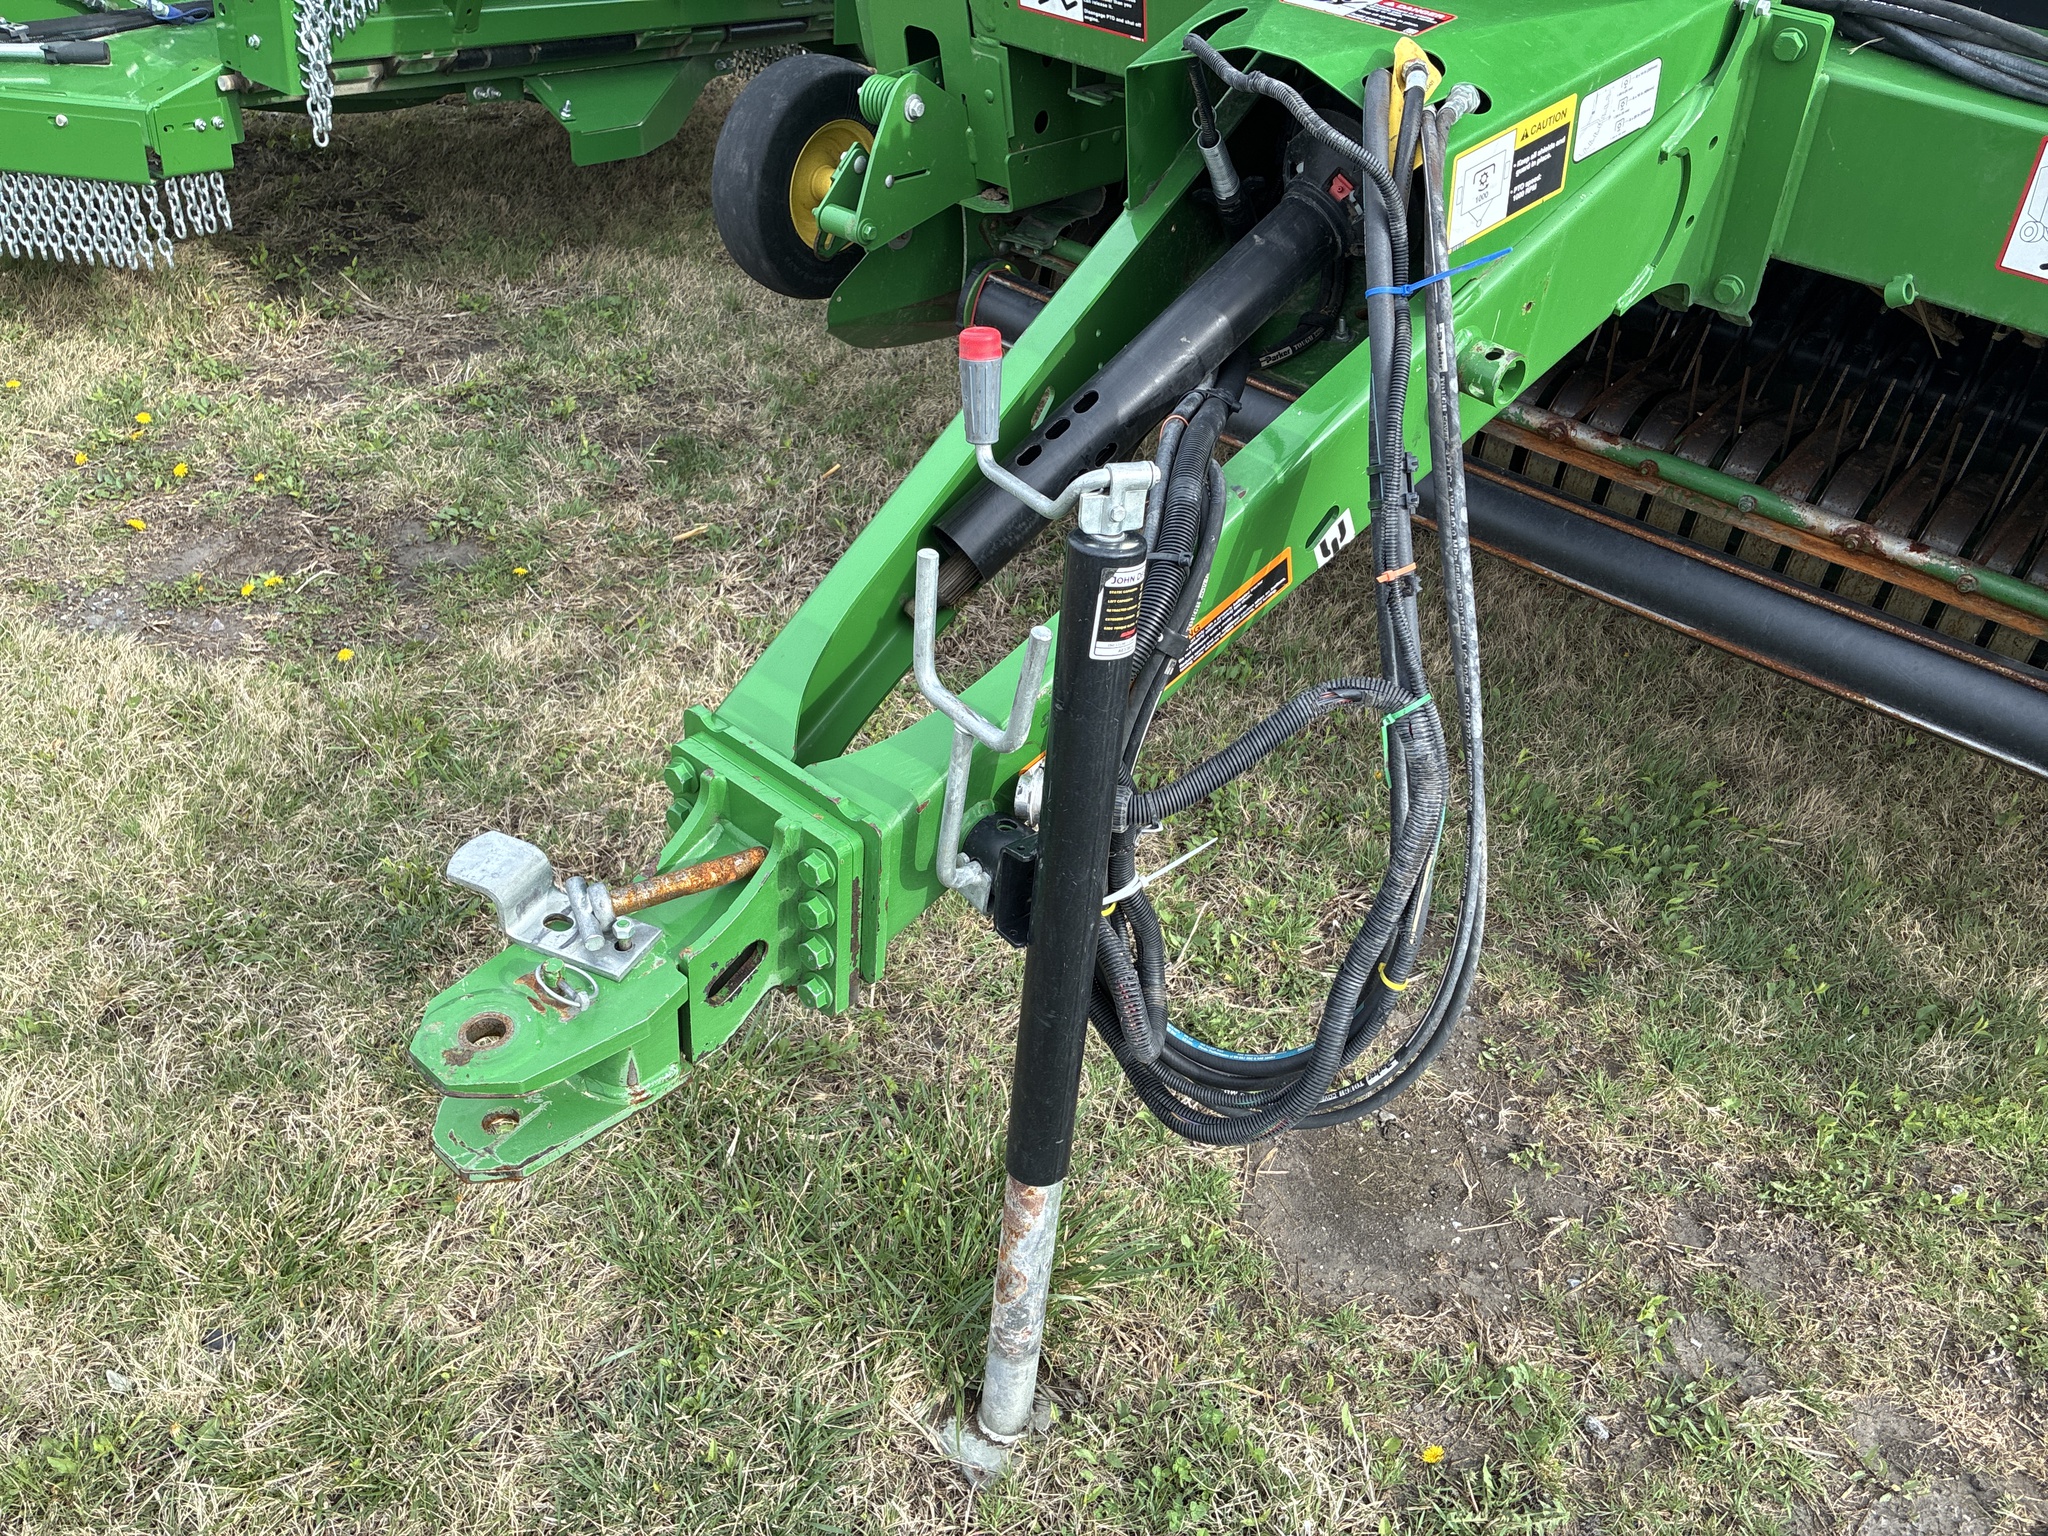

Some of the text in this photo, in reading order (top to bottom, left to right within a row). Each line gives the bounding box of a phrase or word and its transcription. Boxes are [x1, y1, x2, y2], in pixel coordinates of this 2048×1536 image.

[1084, 8, 1105, 18] Disengage
[1396, 3, 1446, 19] DANGER
[1531, 108, 1568, 135] CAUTION
[1517, 156, 1530, 167] Keep
[1538, 142, 1555, 156] shields
[1556, 136, 1566, 146] and
[1515, 162, 1530, 177] guard
[1536, 153, 1552, 166] place.
[1513, 174, 1542, 194] PTO speed:
[1513, 183, 1537, 202] 1000 RPM
[1475, 191, 1489, 204] 1000
[1265, 348, 1290, 363] Parker
[1293, 336, 1313, 350] TOUGH
[1111, 575, 1135, 584] JOHN
[1187, 601, 1201, 632] TOUGH
[1367, 1060, 1393, 1080] Parker
[1340, 1081, 1365, 1096] TOUGH
